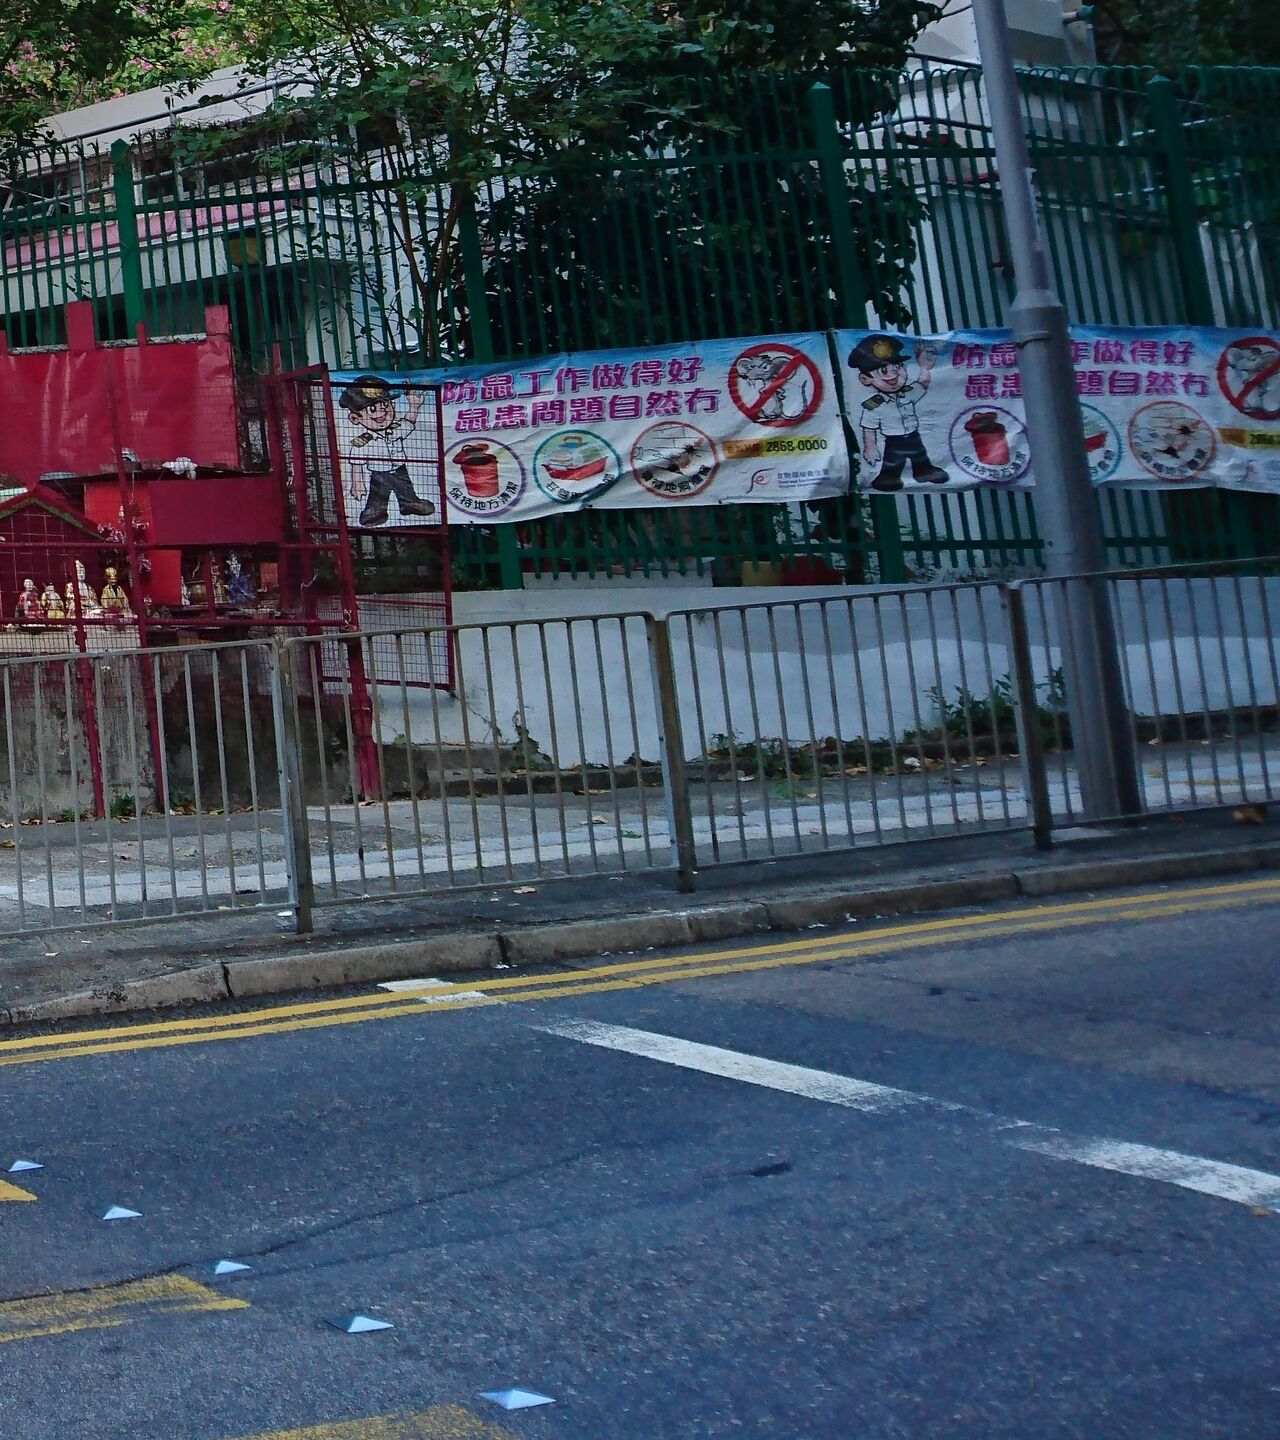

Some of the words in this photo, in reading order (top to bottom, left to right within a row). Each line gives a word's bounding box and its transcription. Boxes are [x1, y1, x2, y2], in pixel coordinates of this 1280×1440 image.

[441, 357, 703, 404] 防鼠工作做得好
[454, 388, 721, 432] 鼠患問題自然冇
[766, 440, 795, 452] 2868
[798, 439, 827, 451] 0000
